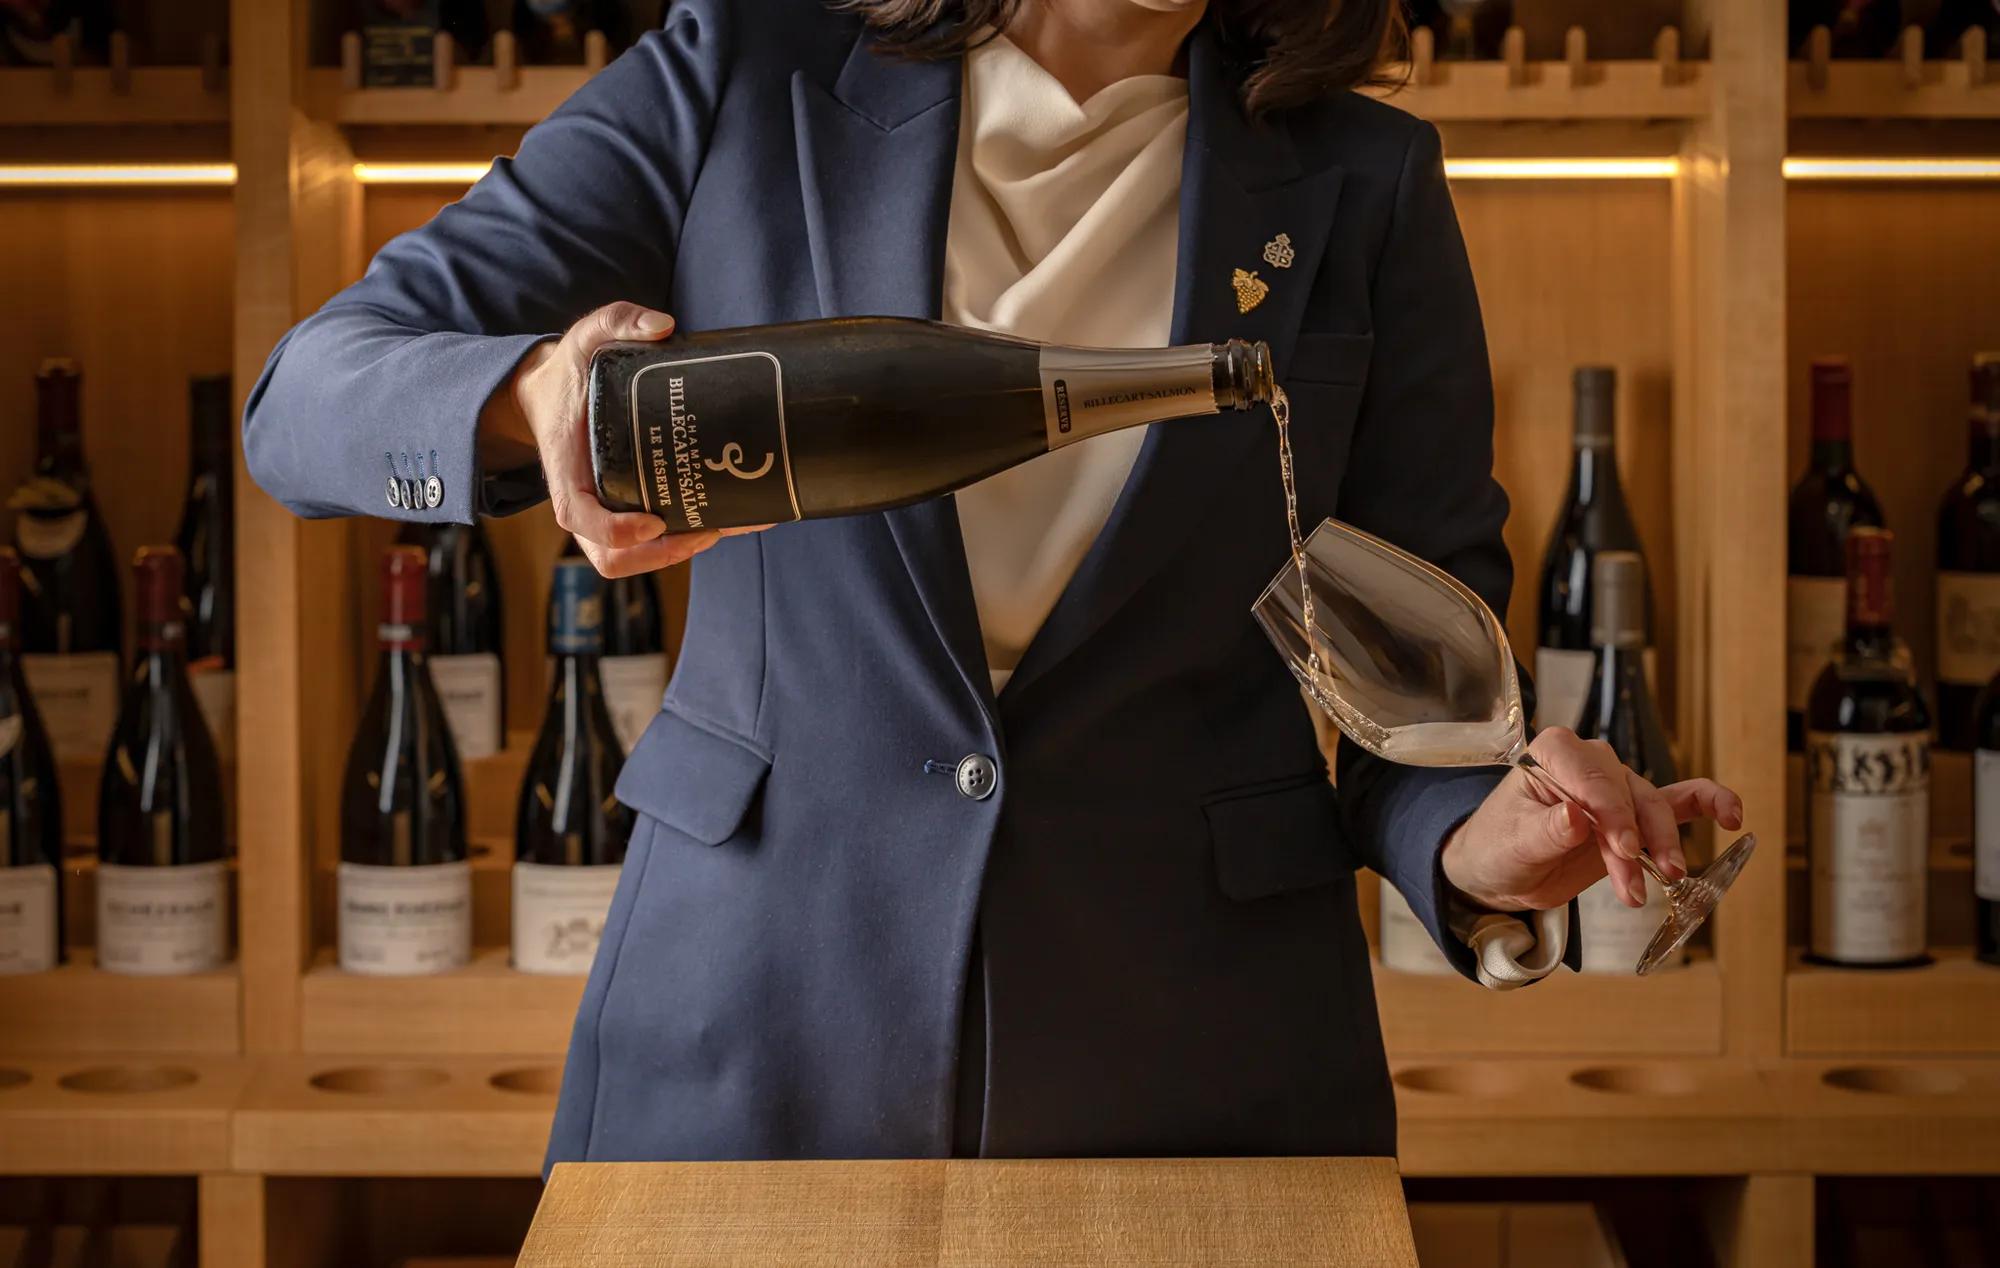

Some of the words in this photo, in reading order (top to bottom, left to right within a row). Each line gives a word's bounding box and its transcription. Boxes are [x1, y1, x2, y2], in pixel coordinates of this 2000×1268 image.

[650, 426, 662, 444] LE
[669, 376, 704, 528] BILLECART-SALMON
[687, 414, 708, 507] CHAMPAGNE
[652, 448, 671, 506] RÉSERVE
